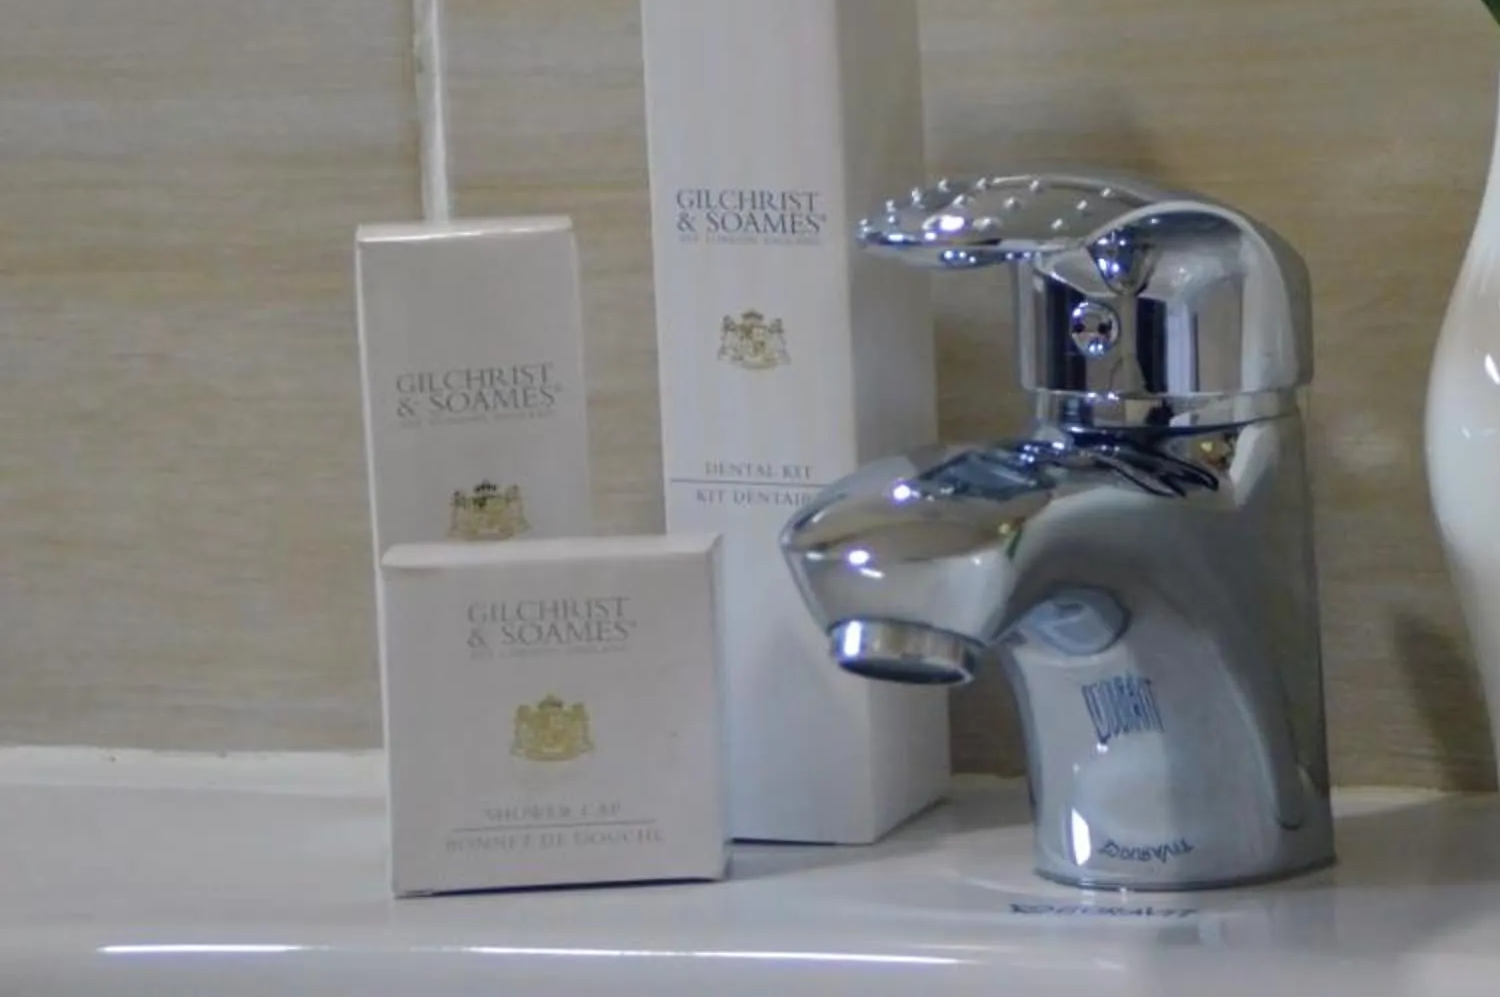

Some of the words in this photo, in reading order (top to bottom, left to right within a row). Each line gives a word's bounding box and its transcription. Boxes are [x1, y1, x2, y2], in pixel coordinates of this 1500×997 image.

[676, 188, 821, 212] GILCHRIST
[676, 211, 697, 233] &
[396, 363, 552, 394] GILCHRIST
[396, 397, 418, 417] &
[466, 597, 630, 624] GILCHRIST
[466, 627, 487, 649] &
